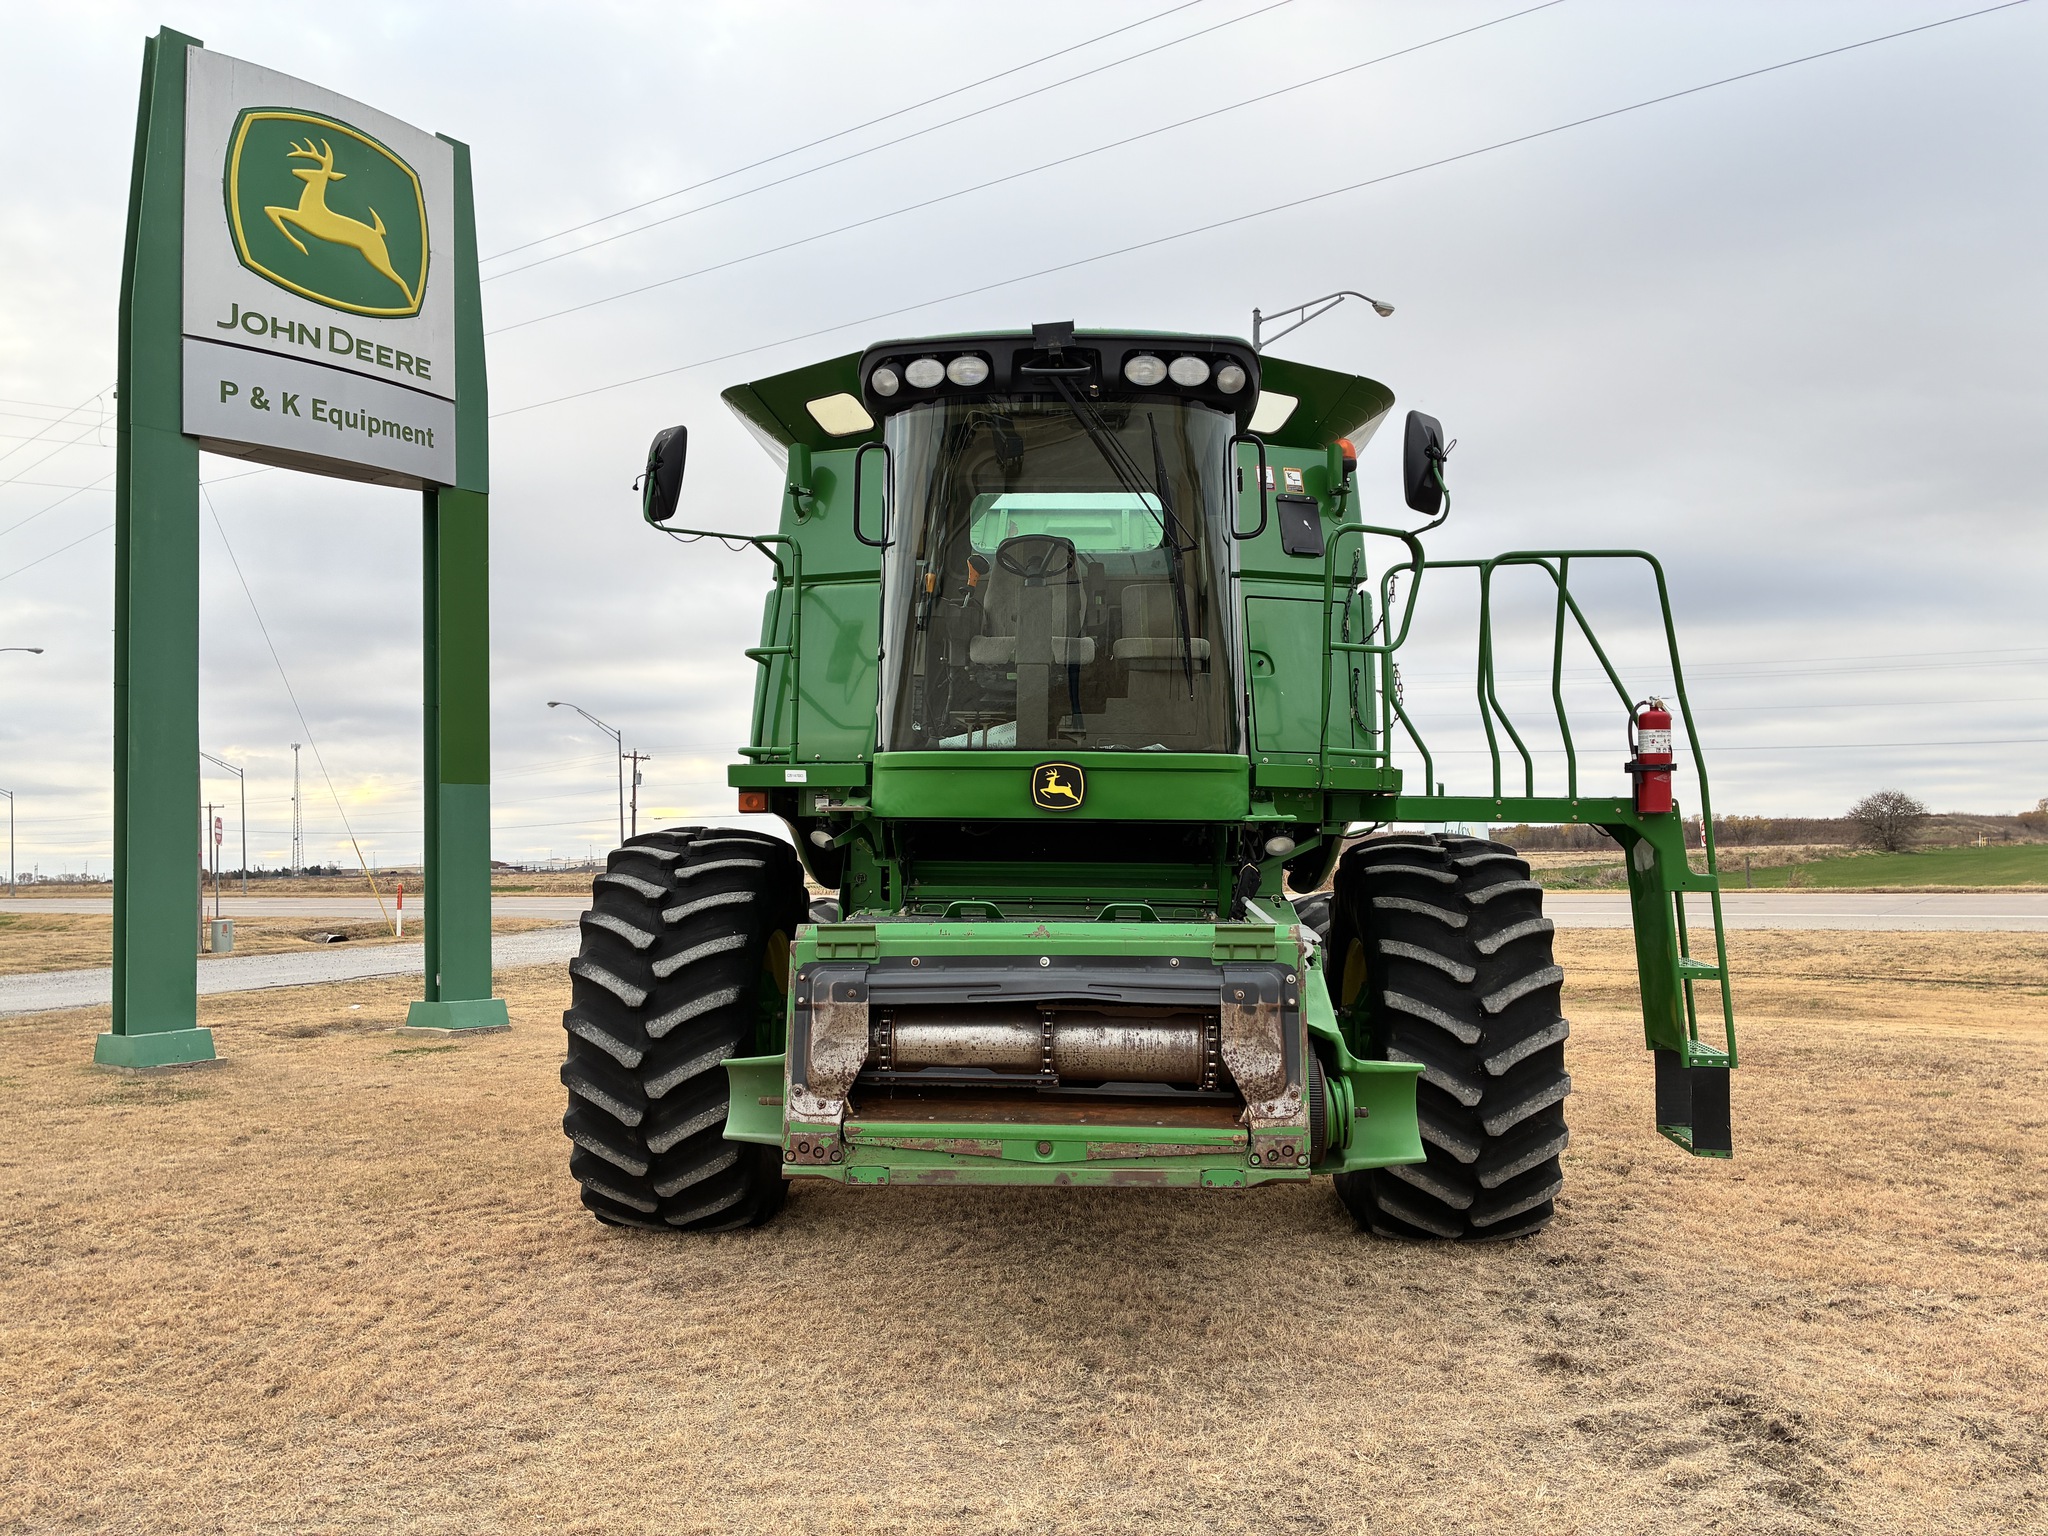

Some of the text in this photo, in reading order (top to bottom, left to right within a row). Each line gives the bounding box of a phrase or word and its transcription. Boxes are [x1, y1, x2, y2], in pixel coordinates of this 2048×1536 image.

[216, 302, 432, 381] JOHN DEERE
[219, 379, 435, 449] P & K Equipment
